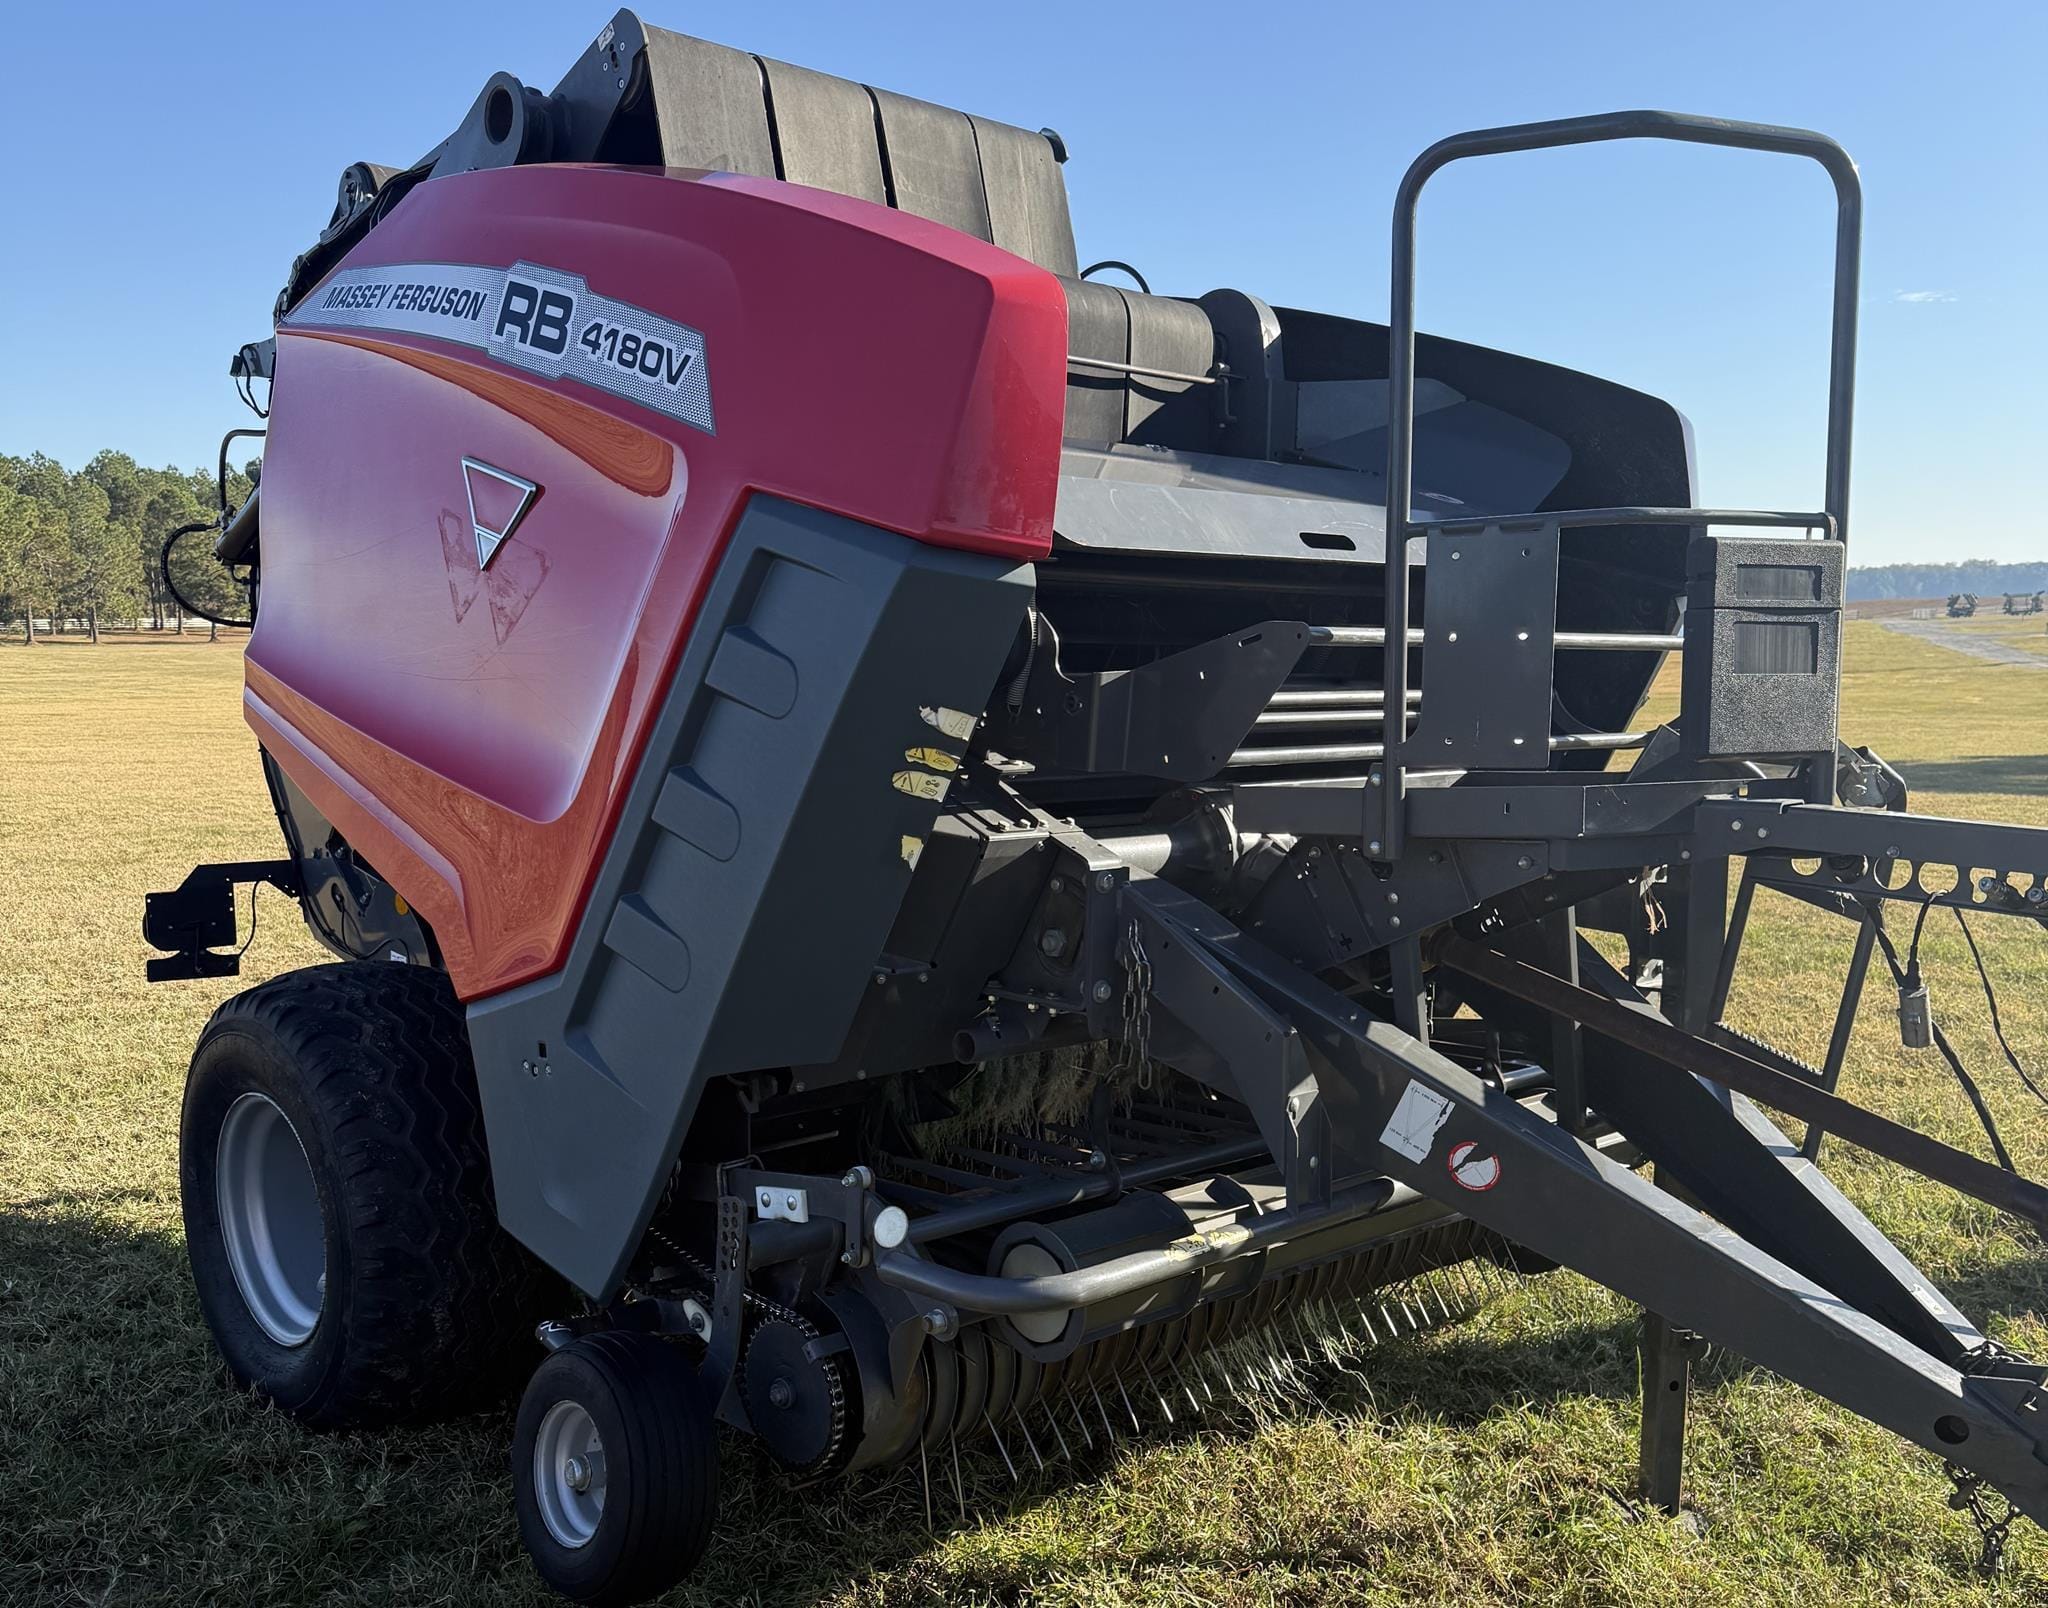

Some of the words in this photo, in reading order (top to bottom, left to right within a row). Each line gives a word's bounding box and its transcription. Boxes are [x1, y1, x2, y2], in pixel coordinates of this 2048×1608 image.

[322, 284, 392, 309] MASSEY
[387, 284, 487, 321] FERGUSON
[495, 280, 574, 355] RB
[581, 322, 691, 386] 4180V
